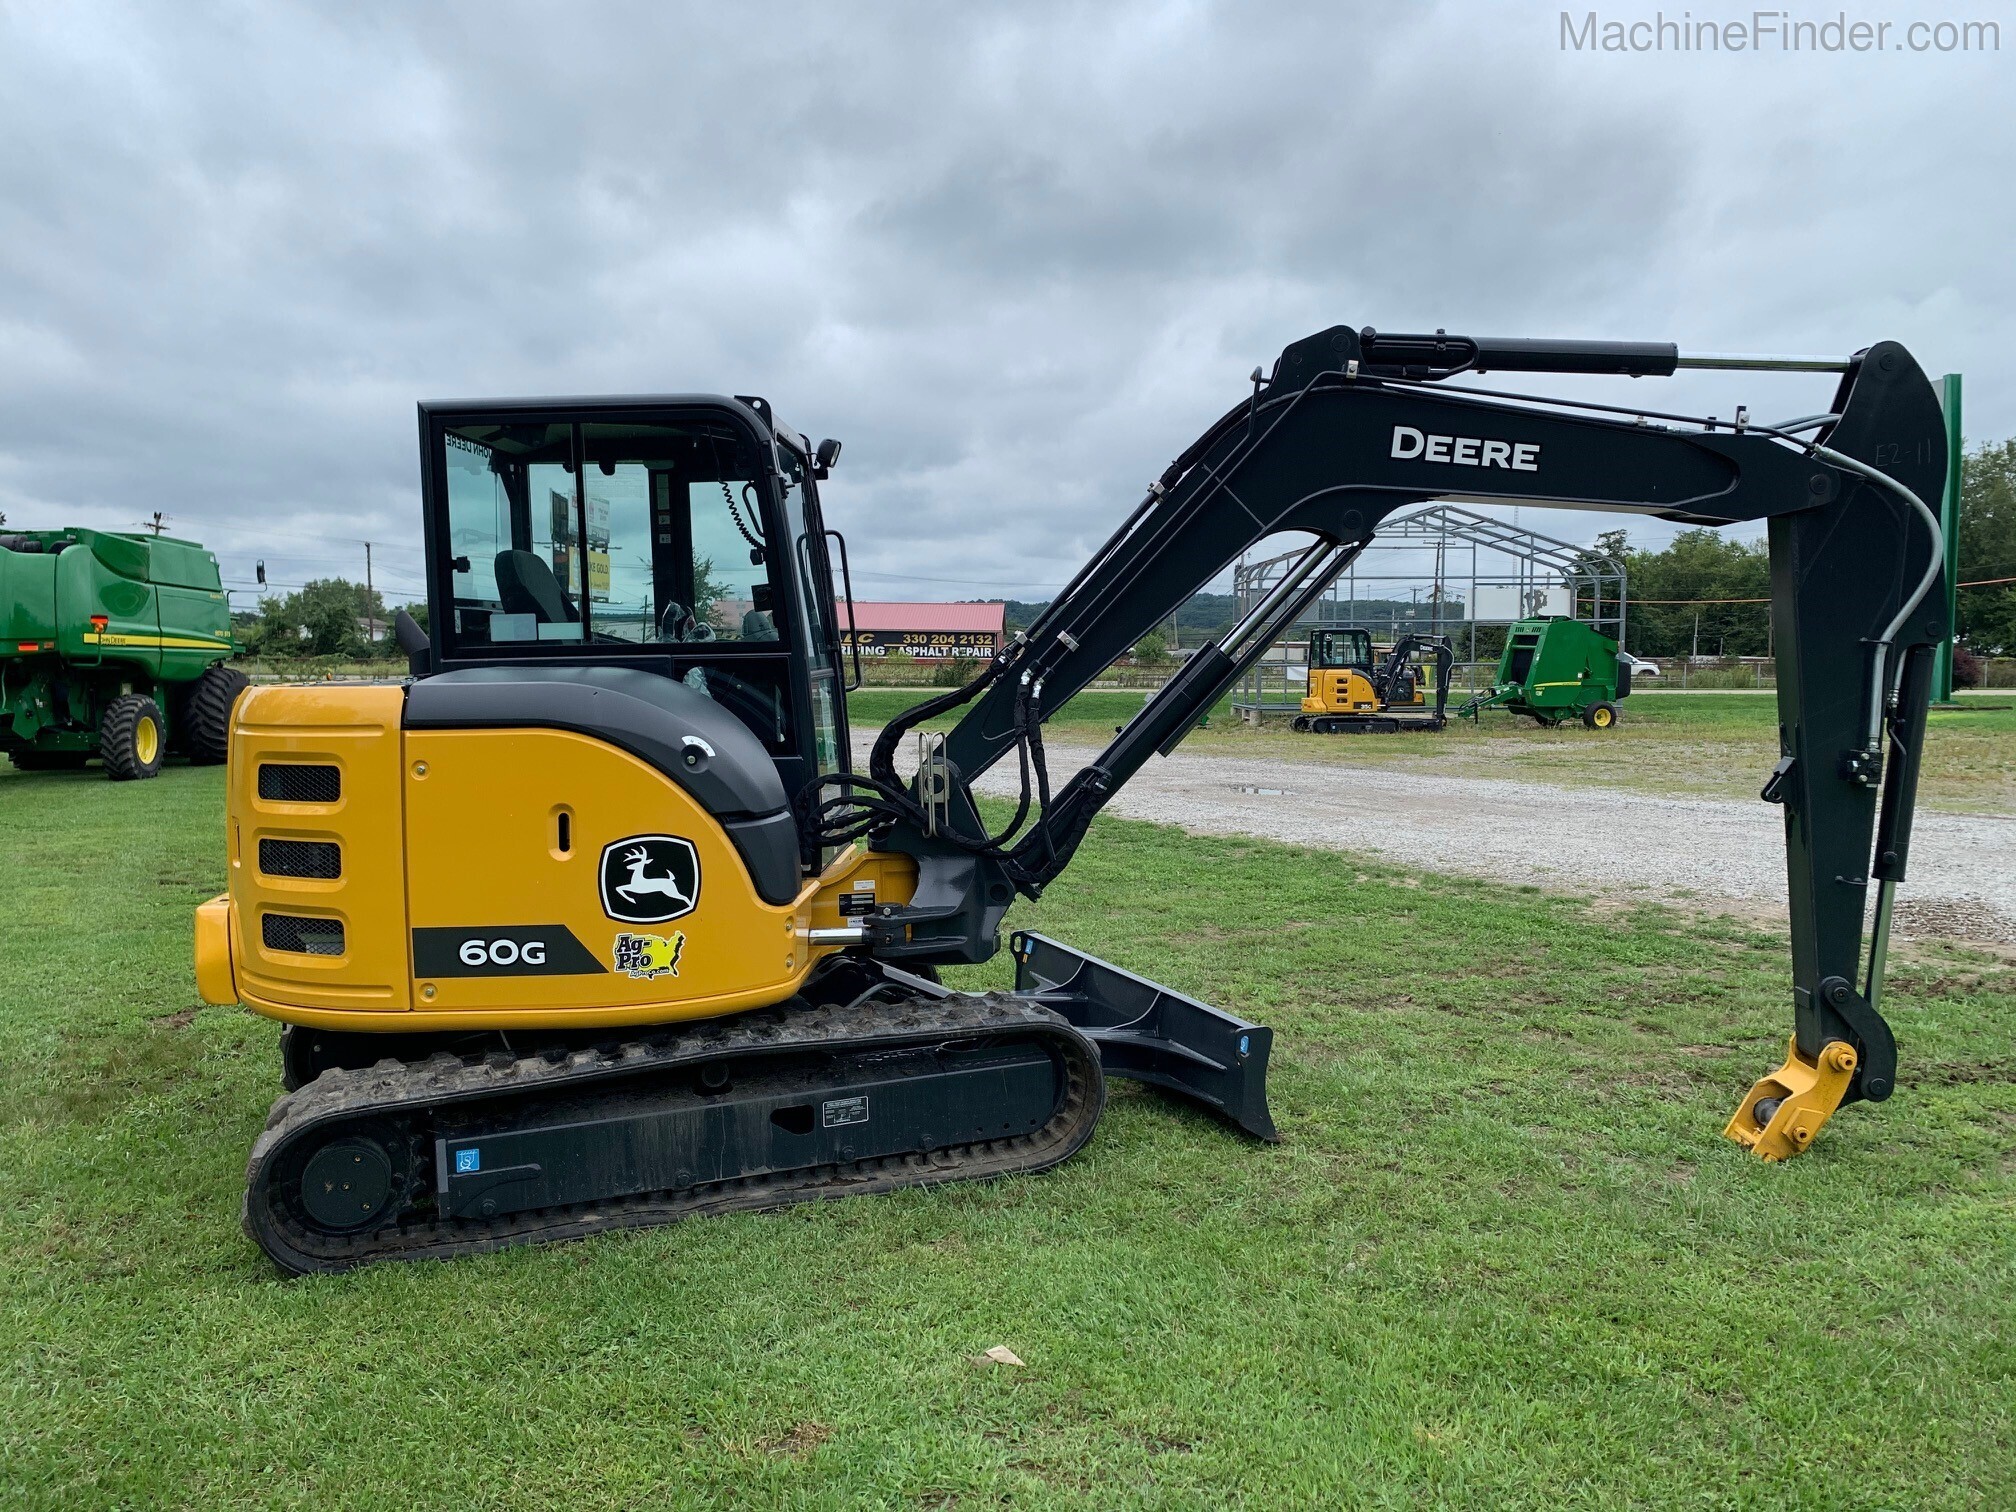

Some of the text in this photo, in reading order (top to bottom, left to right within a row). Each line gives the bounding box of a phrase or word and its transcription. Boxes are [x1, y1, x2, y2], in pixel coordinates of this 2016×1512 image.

[1390, 425, 1540, 472] DEERE
[903, 634, 927, 644] 330
[931, 634, 955, 644] 204
[959, 634, 992, 644] 2132
[899, 646, 948, 656] ASPHALT
[952, 647, 992, 657] REPAIR
[459, 939, 546, 966] 60G
[617, 936, 651, 955] Ag-
[618, 953, 652, 969] Pro
